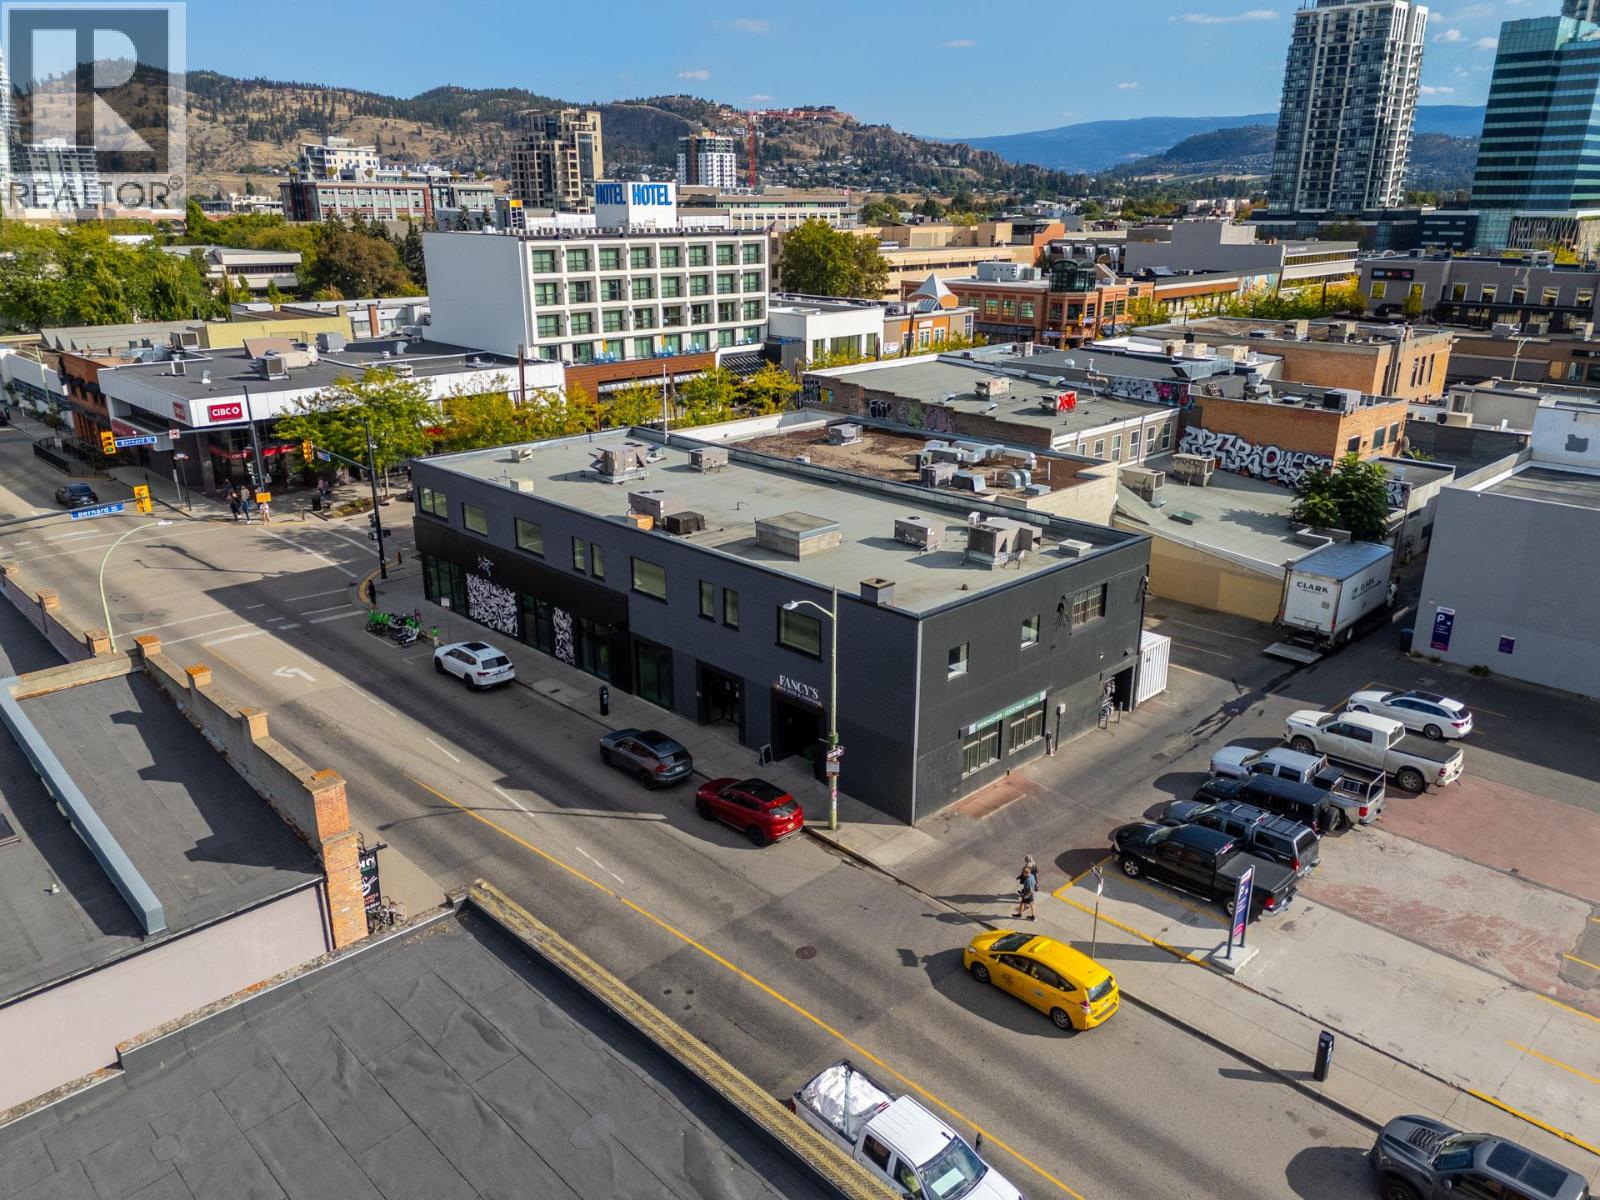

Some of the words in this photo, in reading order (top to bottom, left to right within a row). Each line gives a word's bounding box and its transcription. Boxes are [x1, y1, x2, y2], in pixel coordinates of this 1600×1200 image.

[595, 184, 626, 205] HOTEL
[632, 184, 673, 206] HOTEL
[212, 407, 232, 417] CIBC
[78, 506, 109, 517] Bernard
[1297, 581, 1328, 593] CLARK
[1437, 614, 1445, 622] P
[780, 674, 819, 699] FANCY'S
